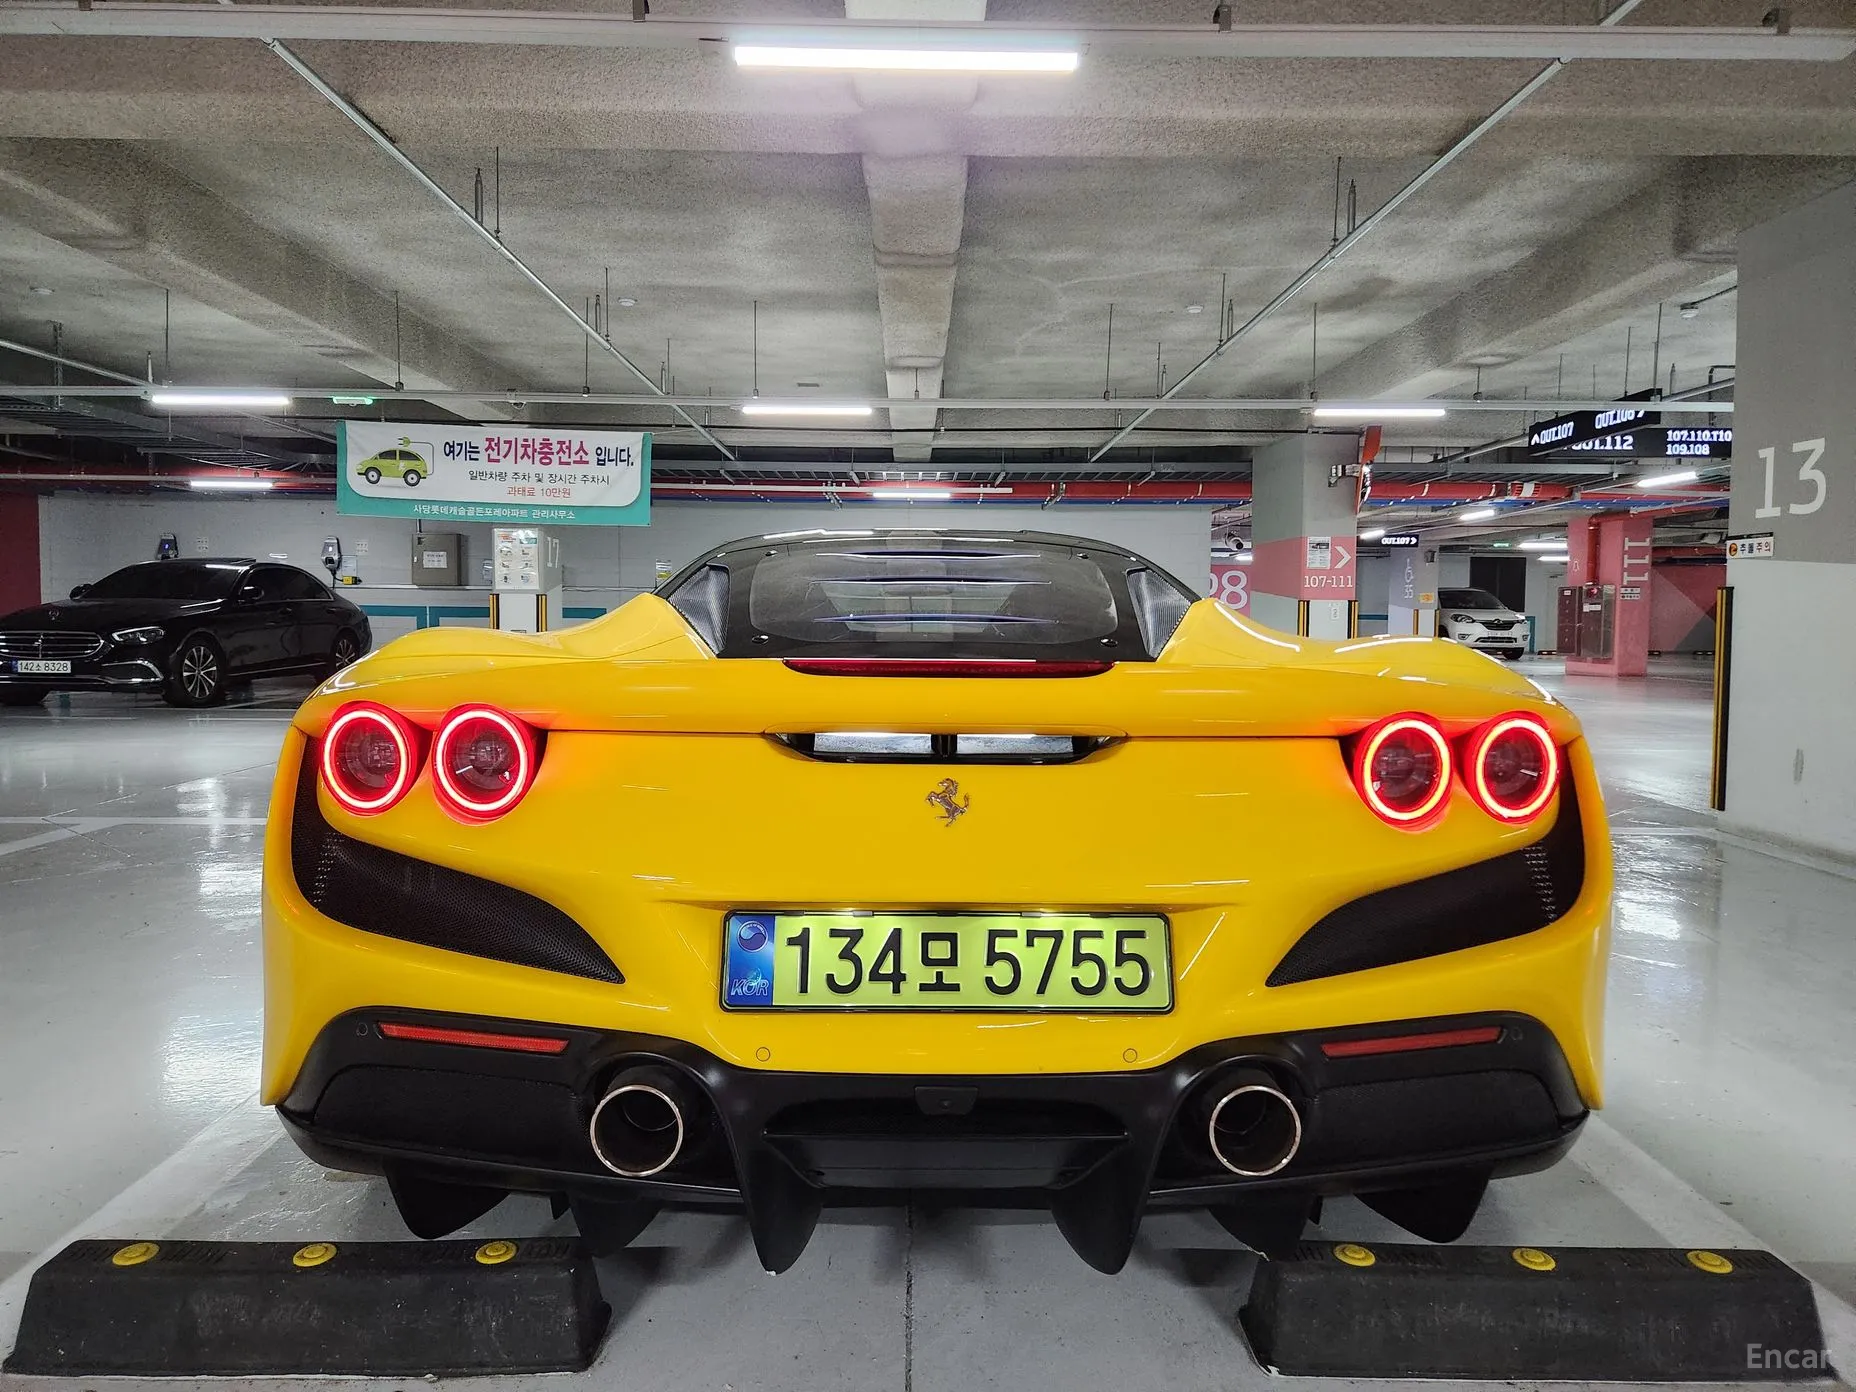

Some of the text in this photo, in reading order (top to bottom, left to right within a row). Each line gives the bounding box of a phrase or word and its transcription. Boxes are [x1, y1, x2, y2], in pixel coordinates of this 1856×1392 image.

[1540, 421, 1574, 444] OUT.107
[443, 436, 634, 467] 여기는 전기차충전소 입니다.
[1665, 444, 1710, 455] 109.108
[468, 470, 609, 485] 일반차량 주차 및 장시간 주차시
[1755, 438, 1827, 519] 13
[507, 487, 571, 498] 과태료 10만원
[532, 509, 575, 519] 관리사무소
[547, 536, 559, 569] 17
[1304, 575, 1353, 588] 107-111
[20, 662, 68, 672] 142소 8328
[786, 927, 1151, 996] 134모 5755
[731, 979, 769, 996] KOR
